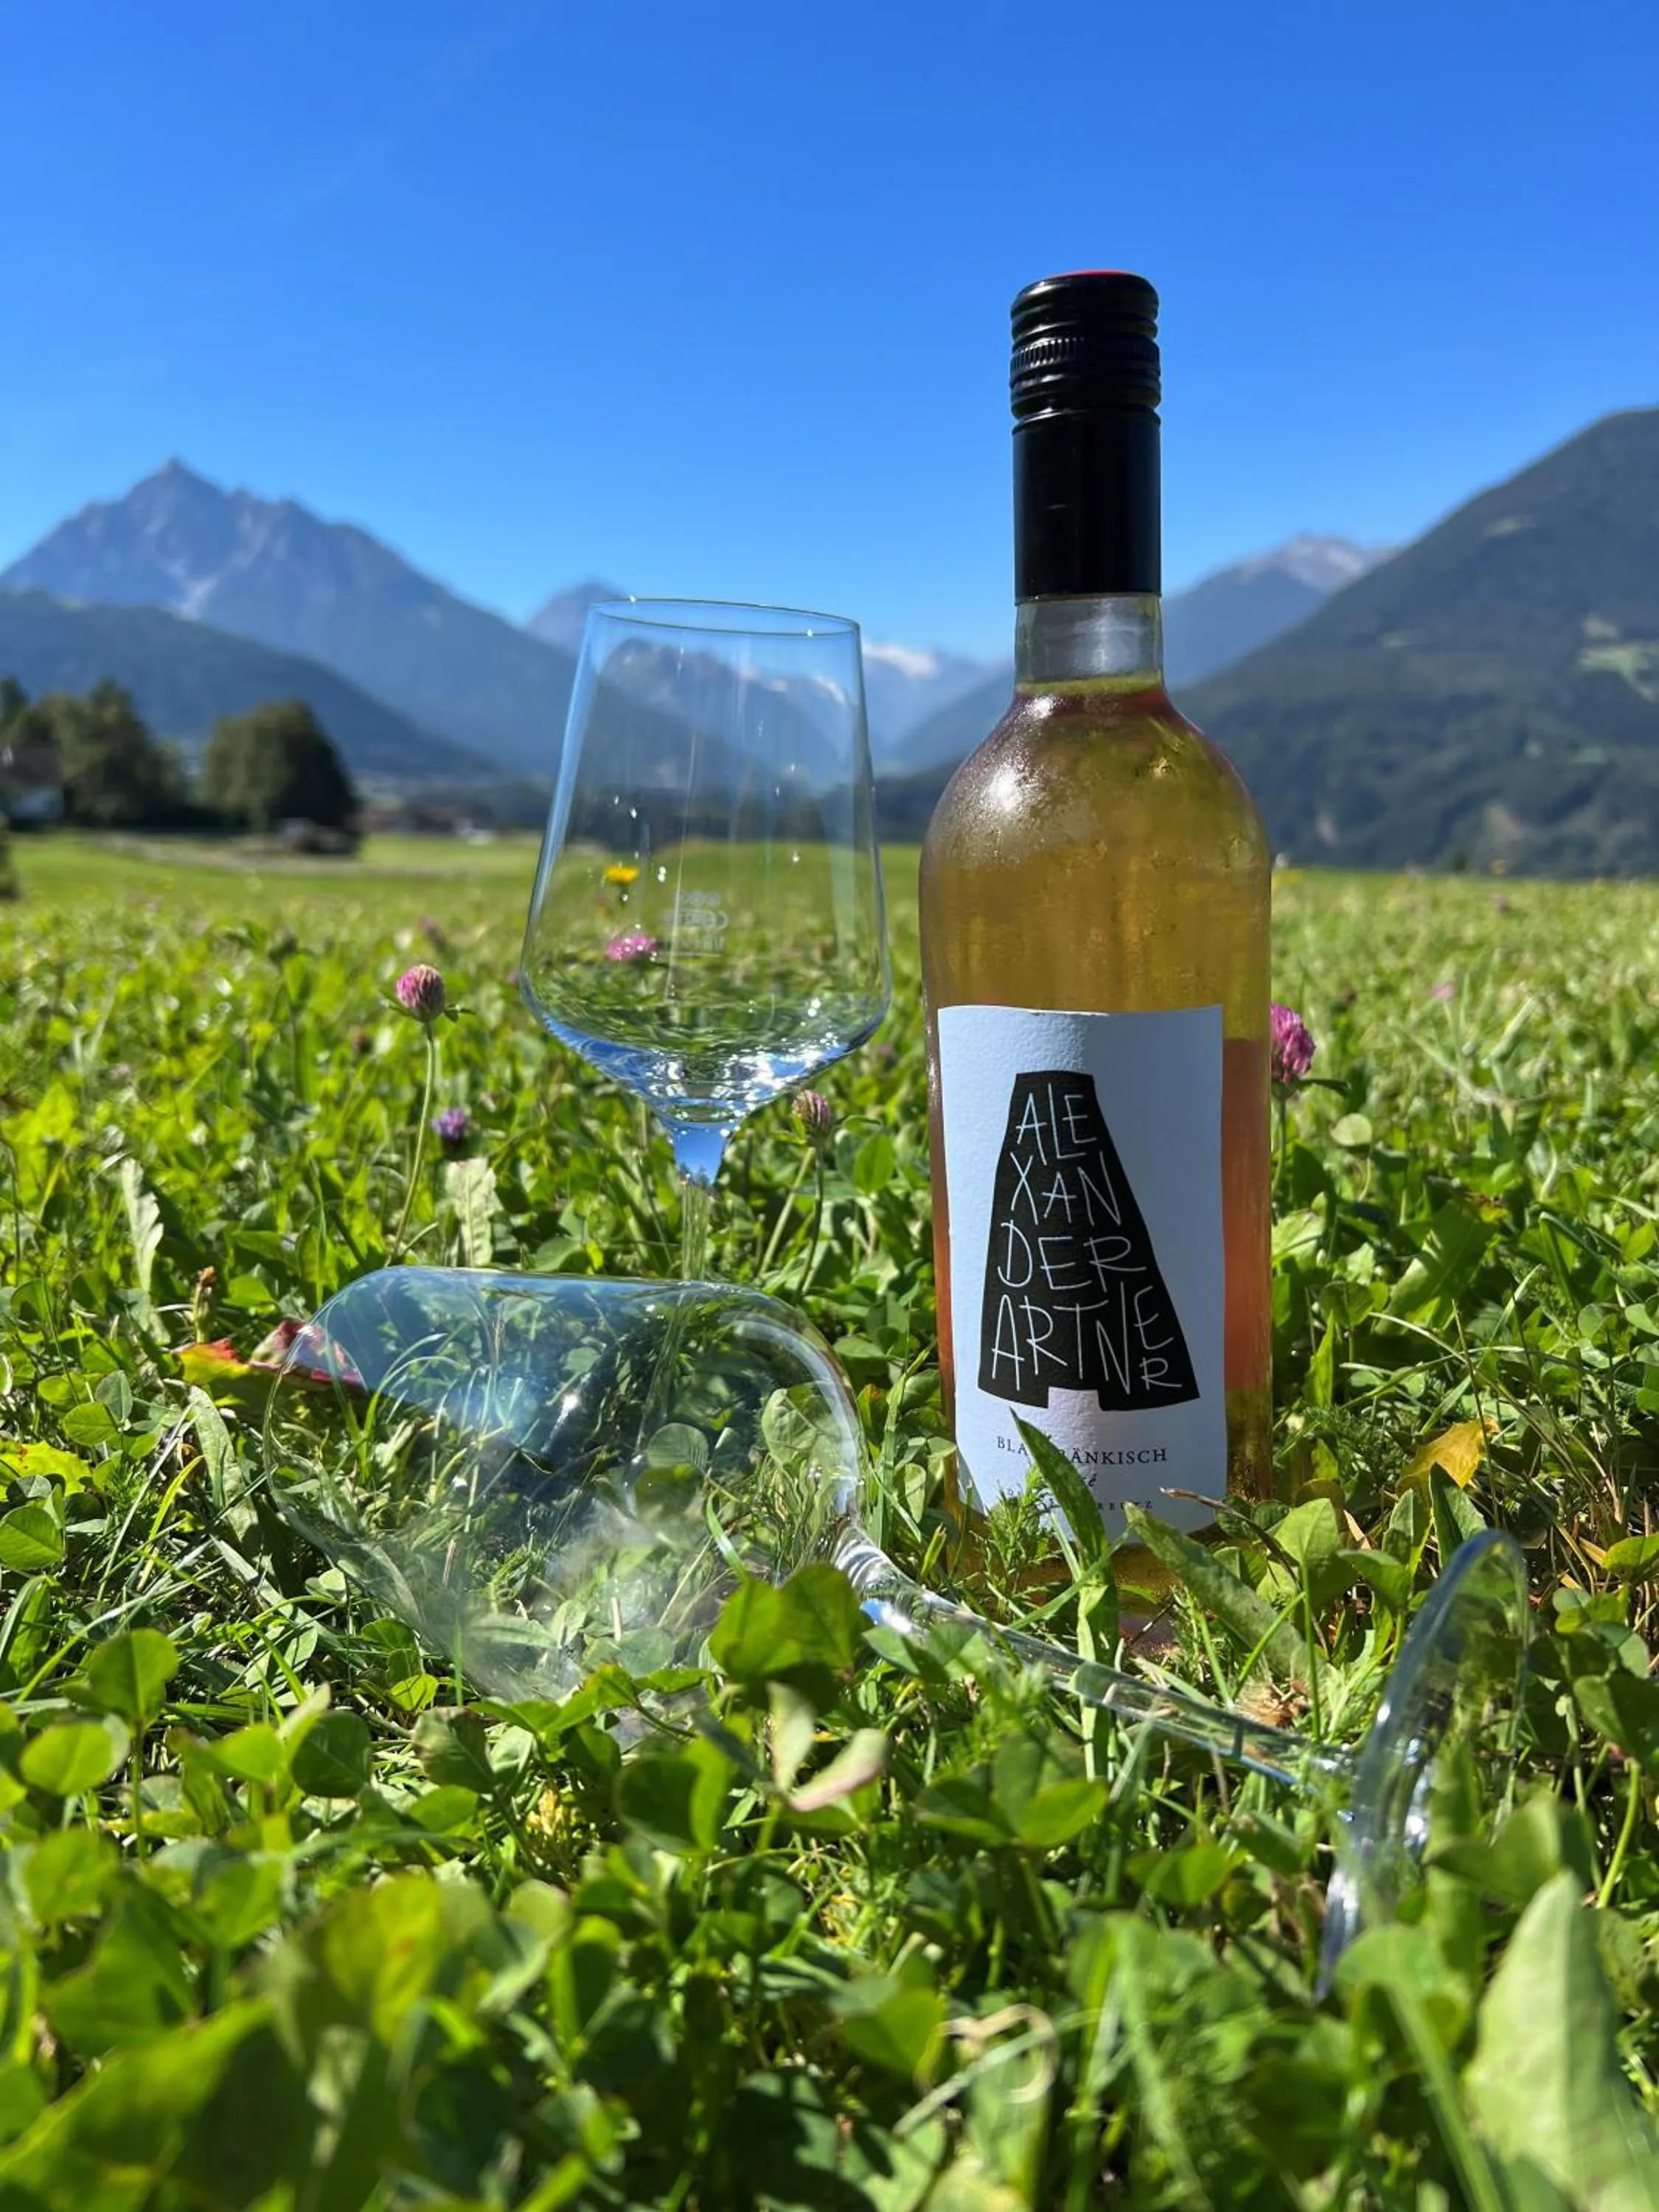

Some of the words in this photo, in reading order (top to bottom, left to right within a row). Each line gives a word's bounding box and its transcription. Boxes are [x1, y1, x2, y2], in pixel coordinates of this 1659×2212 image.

[1015, 1083, 1098, 1166] ALE
[1009, 1151, 1122, 1227] XAN
[997, 1219, 1147, 1293] DER
[996, 1436, 1168, 1465] BLAÄNKISCH
